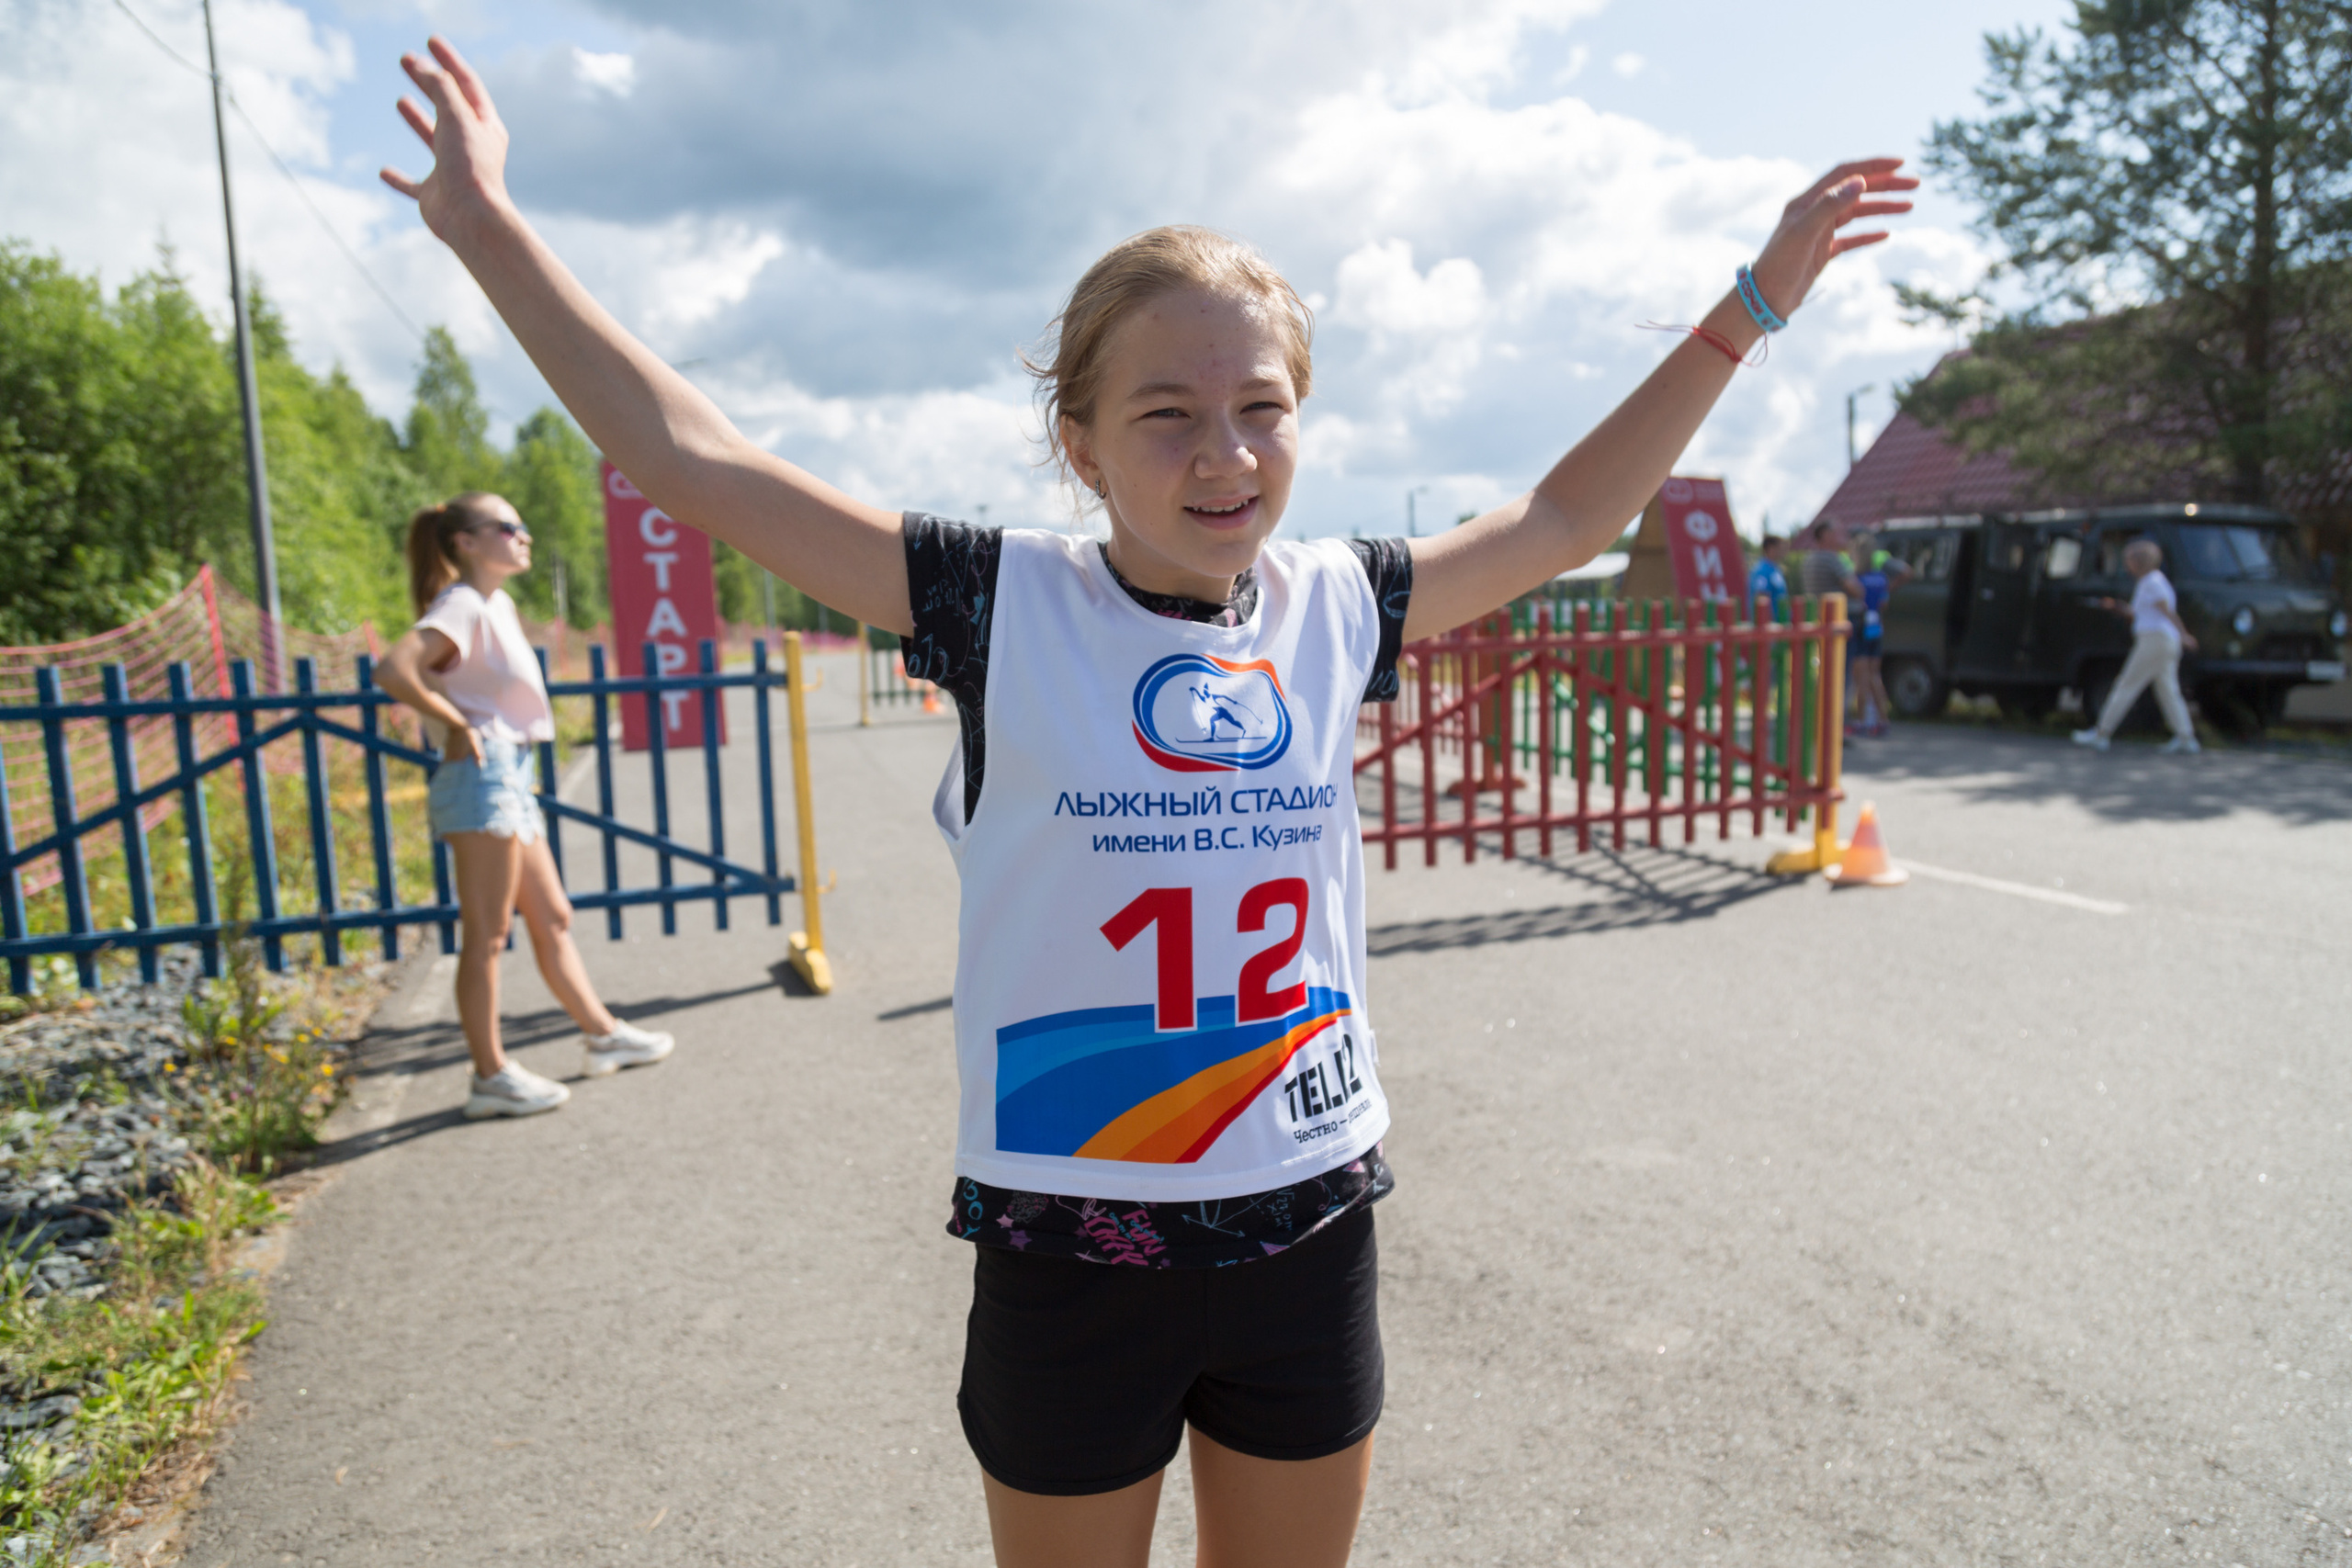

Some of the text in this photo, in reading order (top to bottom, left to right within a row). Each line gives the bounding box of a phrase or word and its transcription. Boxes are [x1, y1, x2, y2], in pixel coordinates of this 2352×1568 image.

[639, 507, 690, 732] СТАРТ
[1055, 783, 1338, 817] ЛЫЖНЫЙ СТАДИОН
[1092, 825, 1322, 852] имени В.С. Кузина
[1100, 877, 1309, 1030] 12
[1294, 1121, 1339, 1144] Честно
